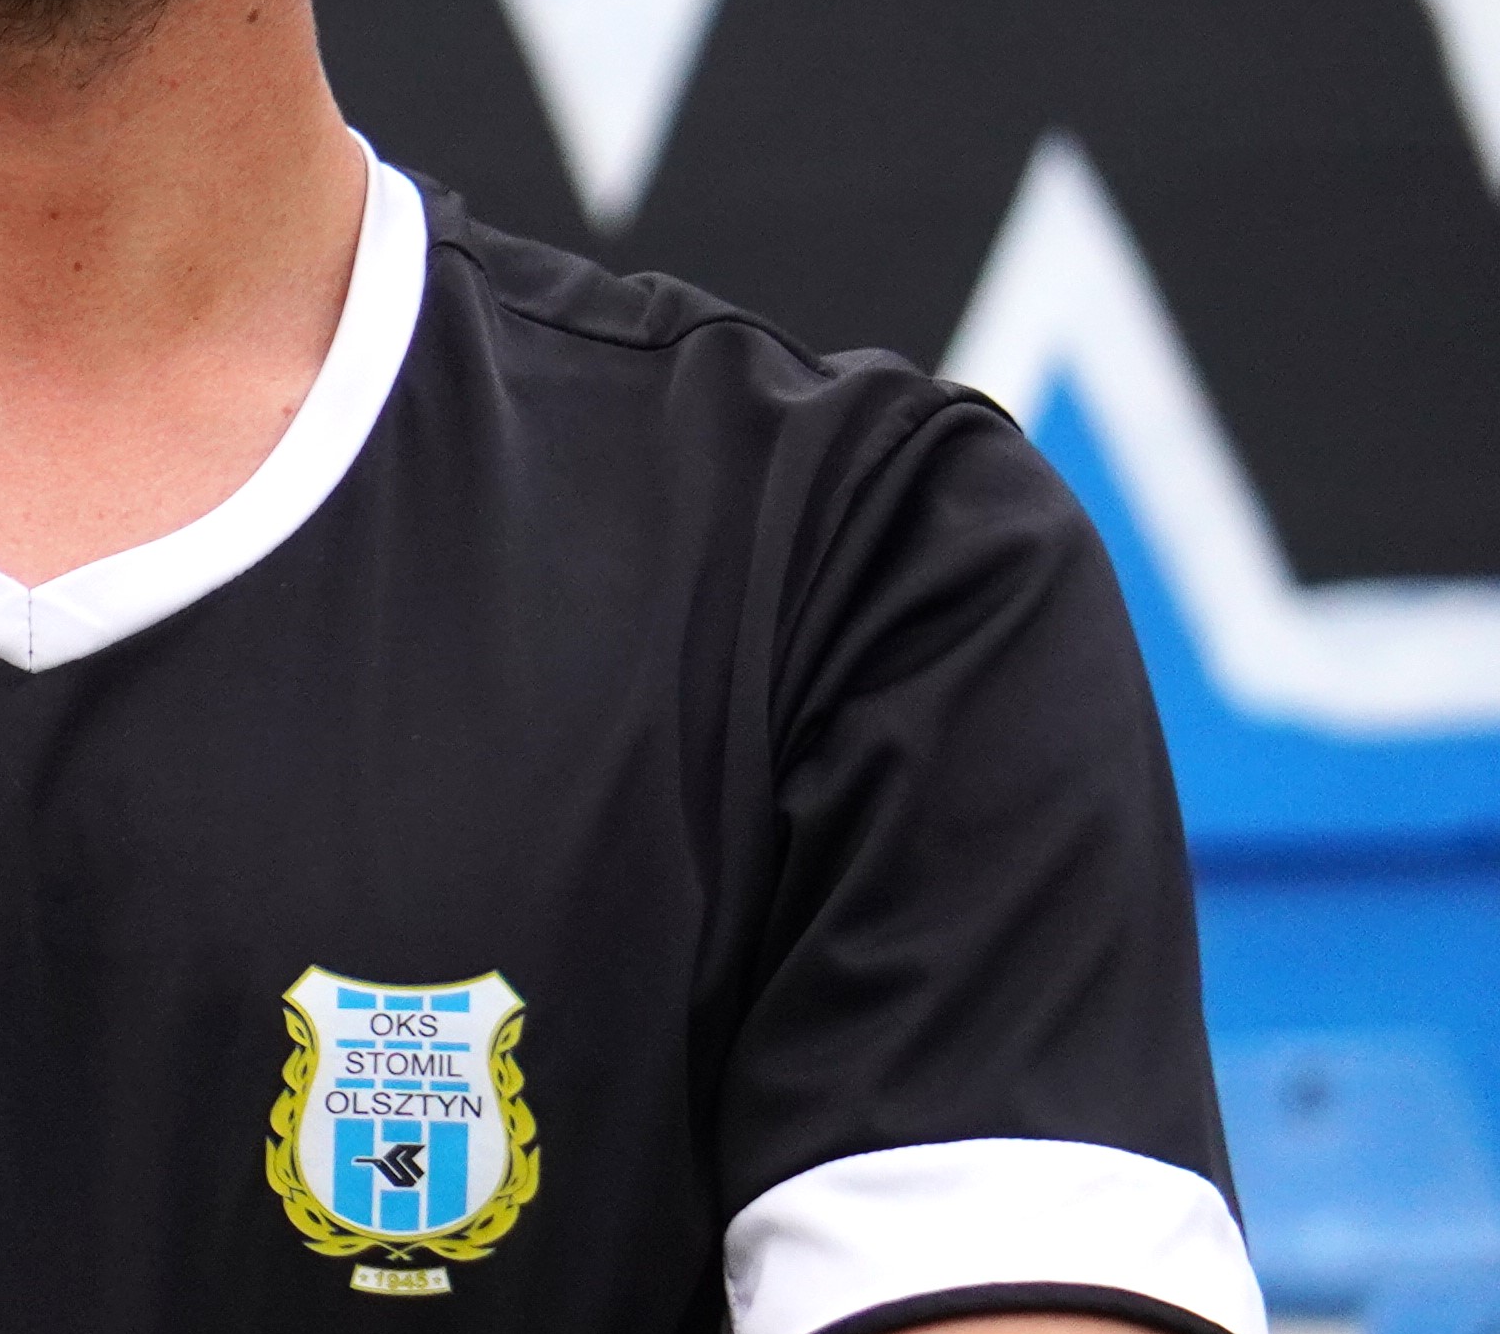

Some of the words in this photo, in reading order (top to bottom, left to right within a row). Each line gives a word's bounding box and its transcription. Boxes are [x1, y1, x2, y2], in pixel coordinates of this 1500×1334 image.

[369, 1012, 438, 1038] OKS
[345, 1051, 463, 1078] STOMIL
[325, 1090, 482, 1119] OLSZTYN
